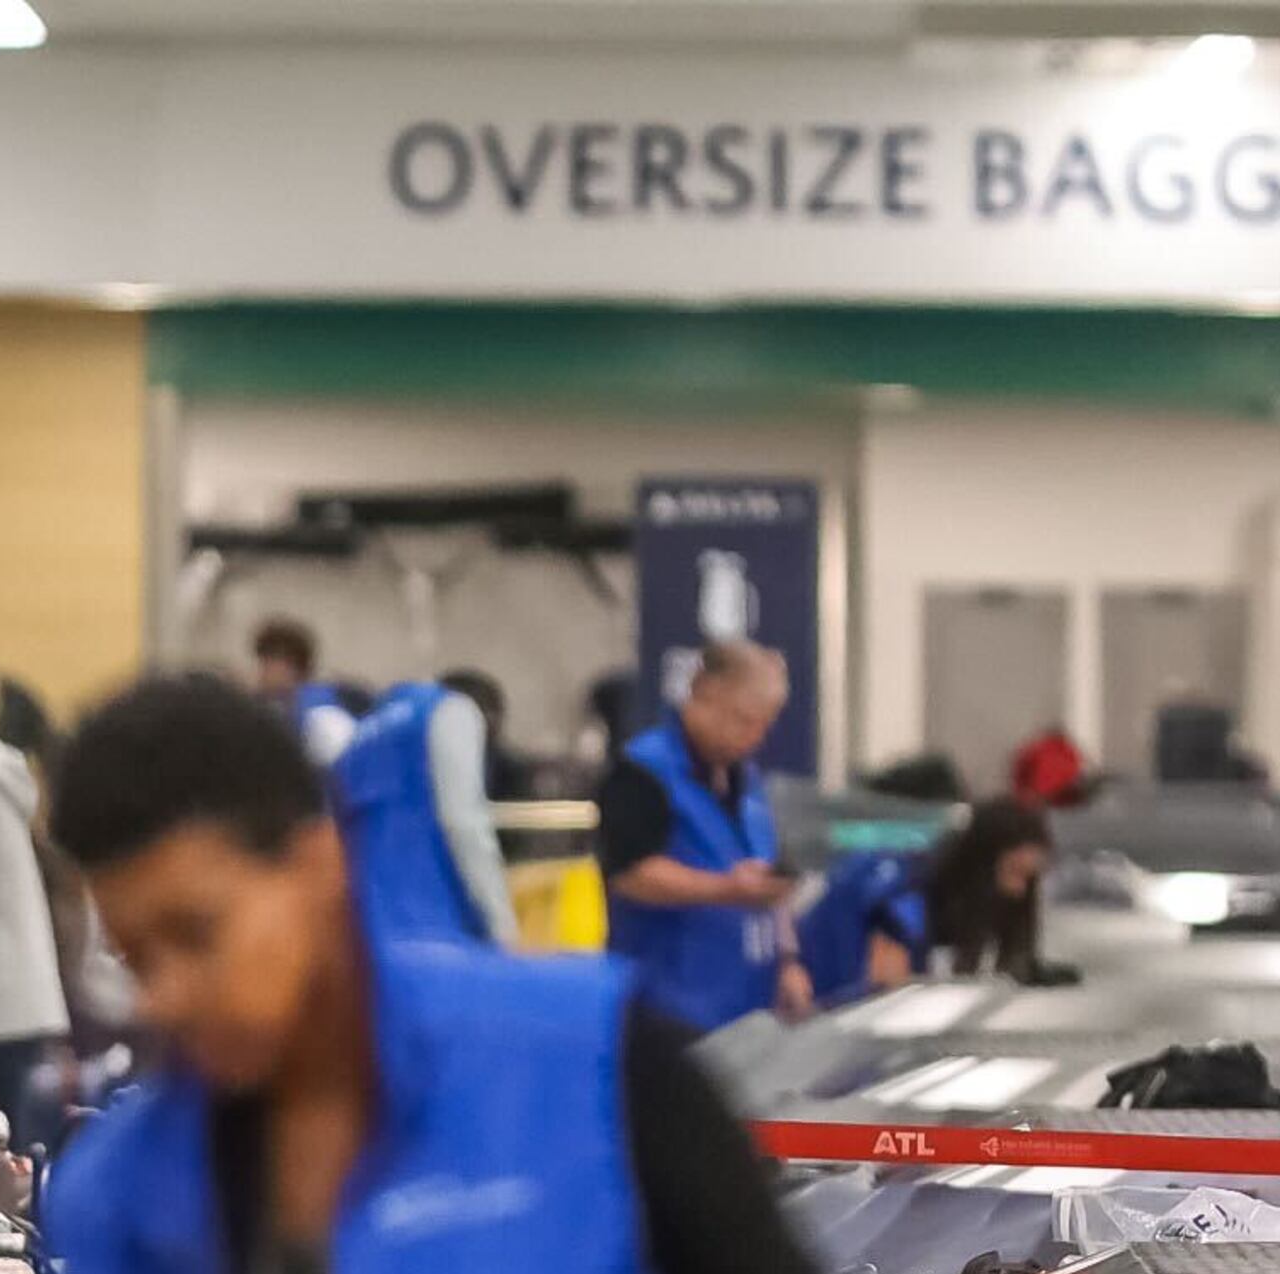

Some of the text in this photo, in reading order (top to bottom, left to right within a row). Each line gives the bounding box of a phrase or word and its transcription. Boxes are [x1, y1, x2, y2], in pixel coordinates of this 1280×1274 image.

[388, 121, 1280, 222] OVERSIZE BAGG
[873, 1130, 936, 1156] ATL
